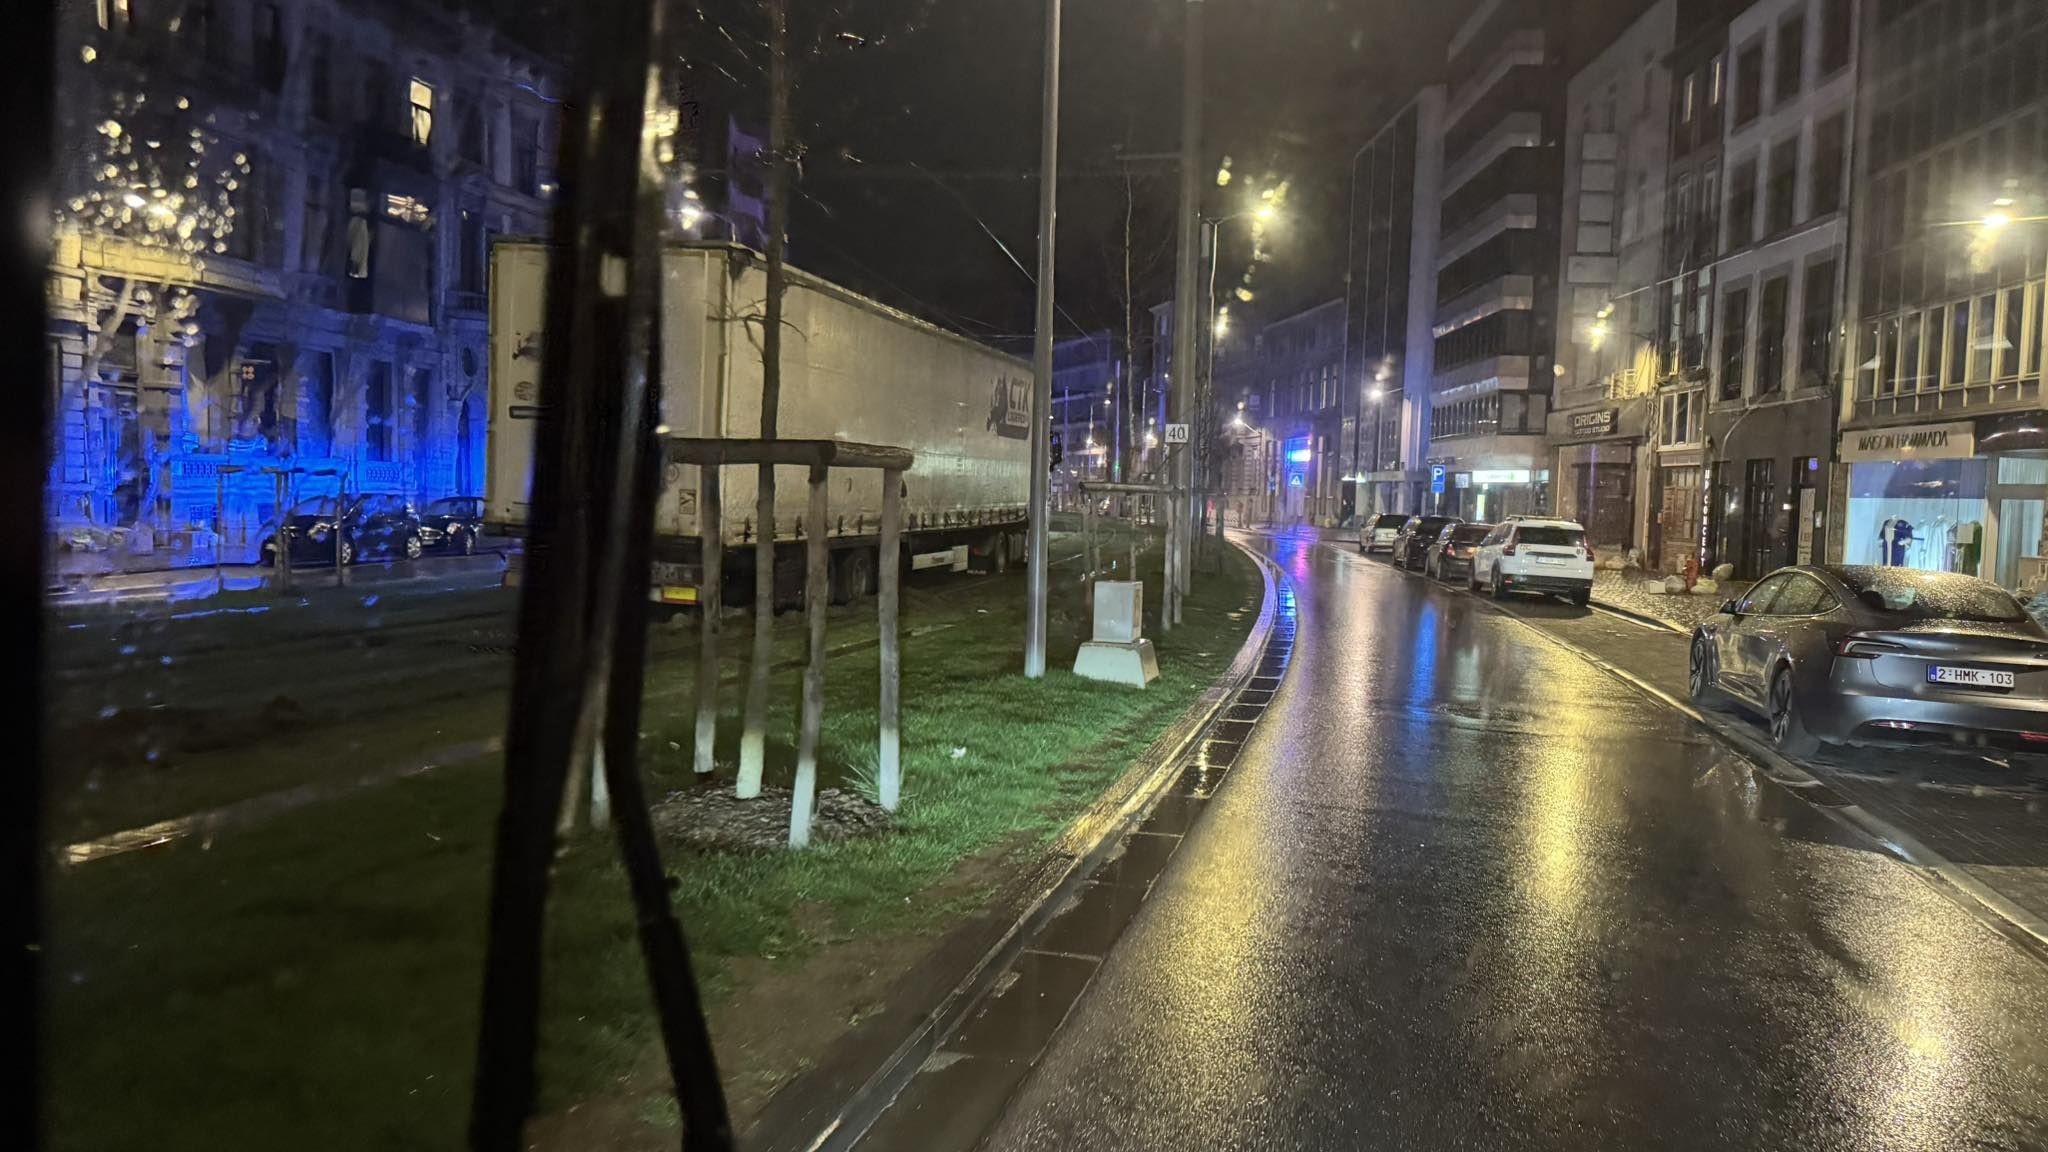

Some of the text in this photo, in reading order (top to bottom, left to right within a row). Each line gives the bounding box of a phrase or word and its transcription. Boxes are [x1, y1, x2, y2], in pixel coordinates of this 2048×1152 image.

[1575, 411, 1611, 427] ORIGINS
[1168, 427, 1185, 440] 40
[1434, 468, 1443, 481] P
[1701, 495, 1709, 567] CONCEPT
